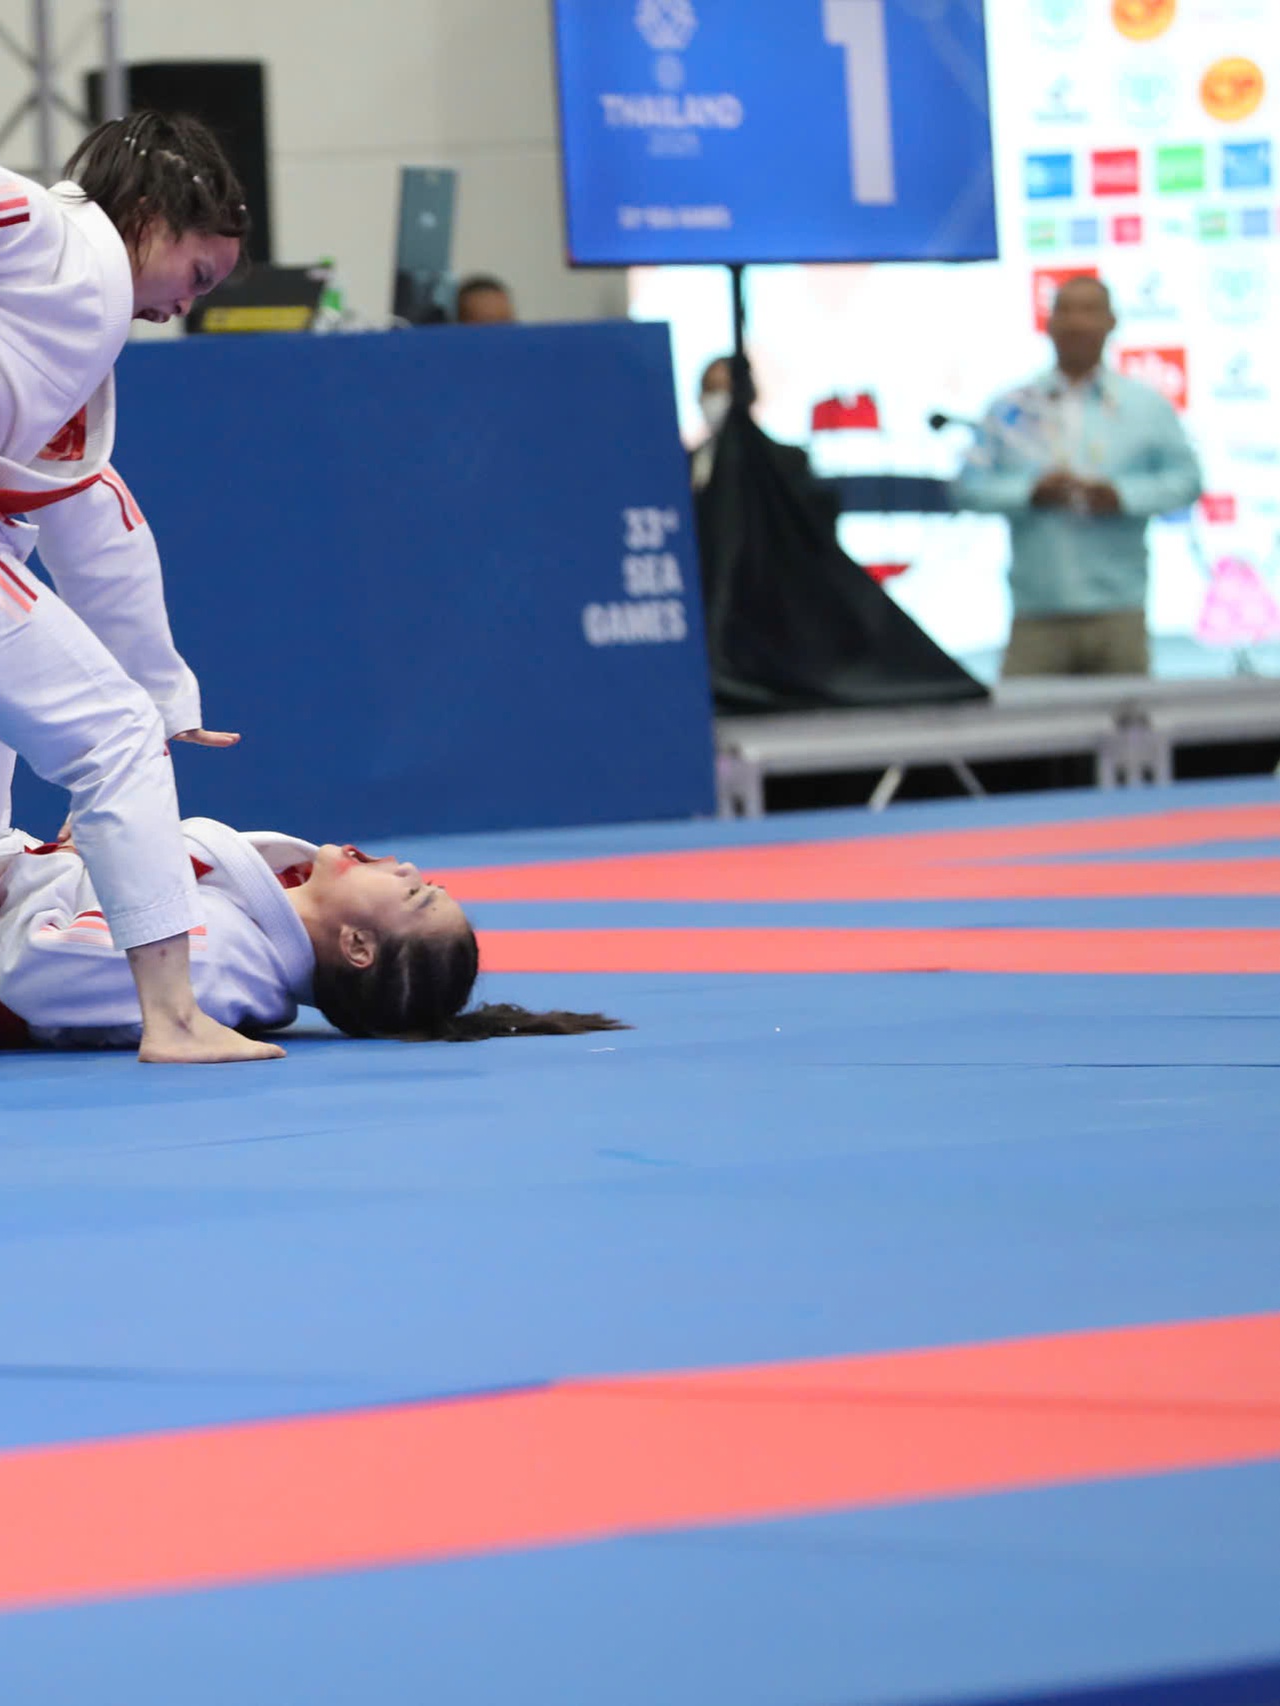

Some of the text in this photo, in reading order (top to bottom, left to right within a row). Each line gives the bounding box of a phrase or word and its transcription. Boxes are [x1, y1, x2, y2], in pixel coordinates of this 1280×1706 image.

[824, 0, 897, 206] 1
[622, 552, 685, 598] SEA
[582, 600, 688, 648] GAMES
